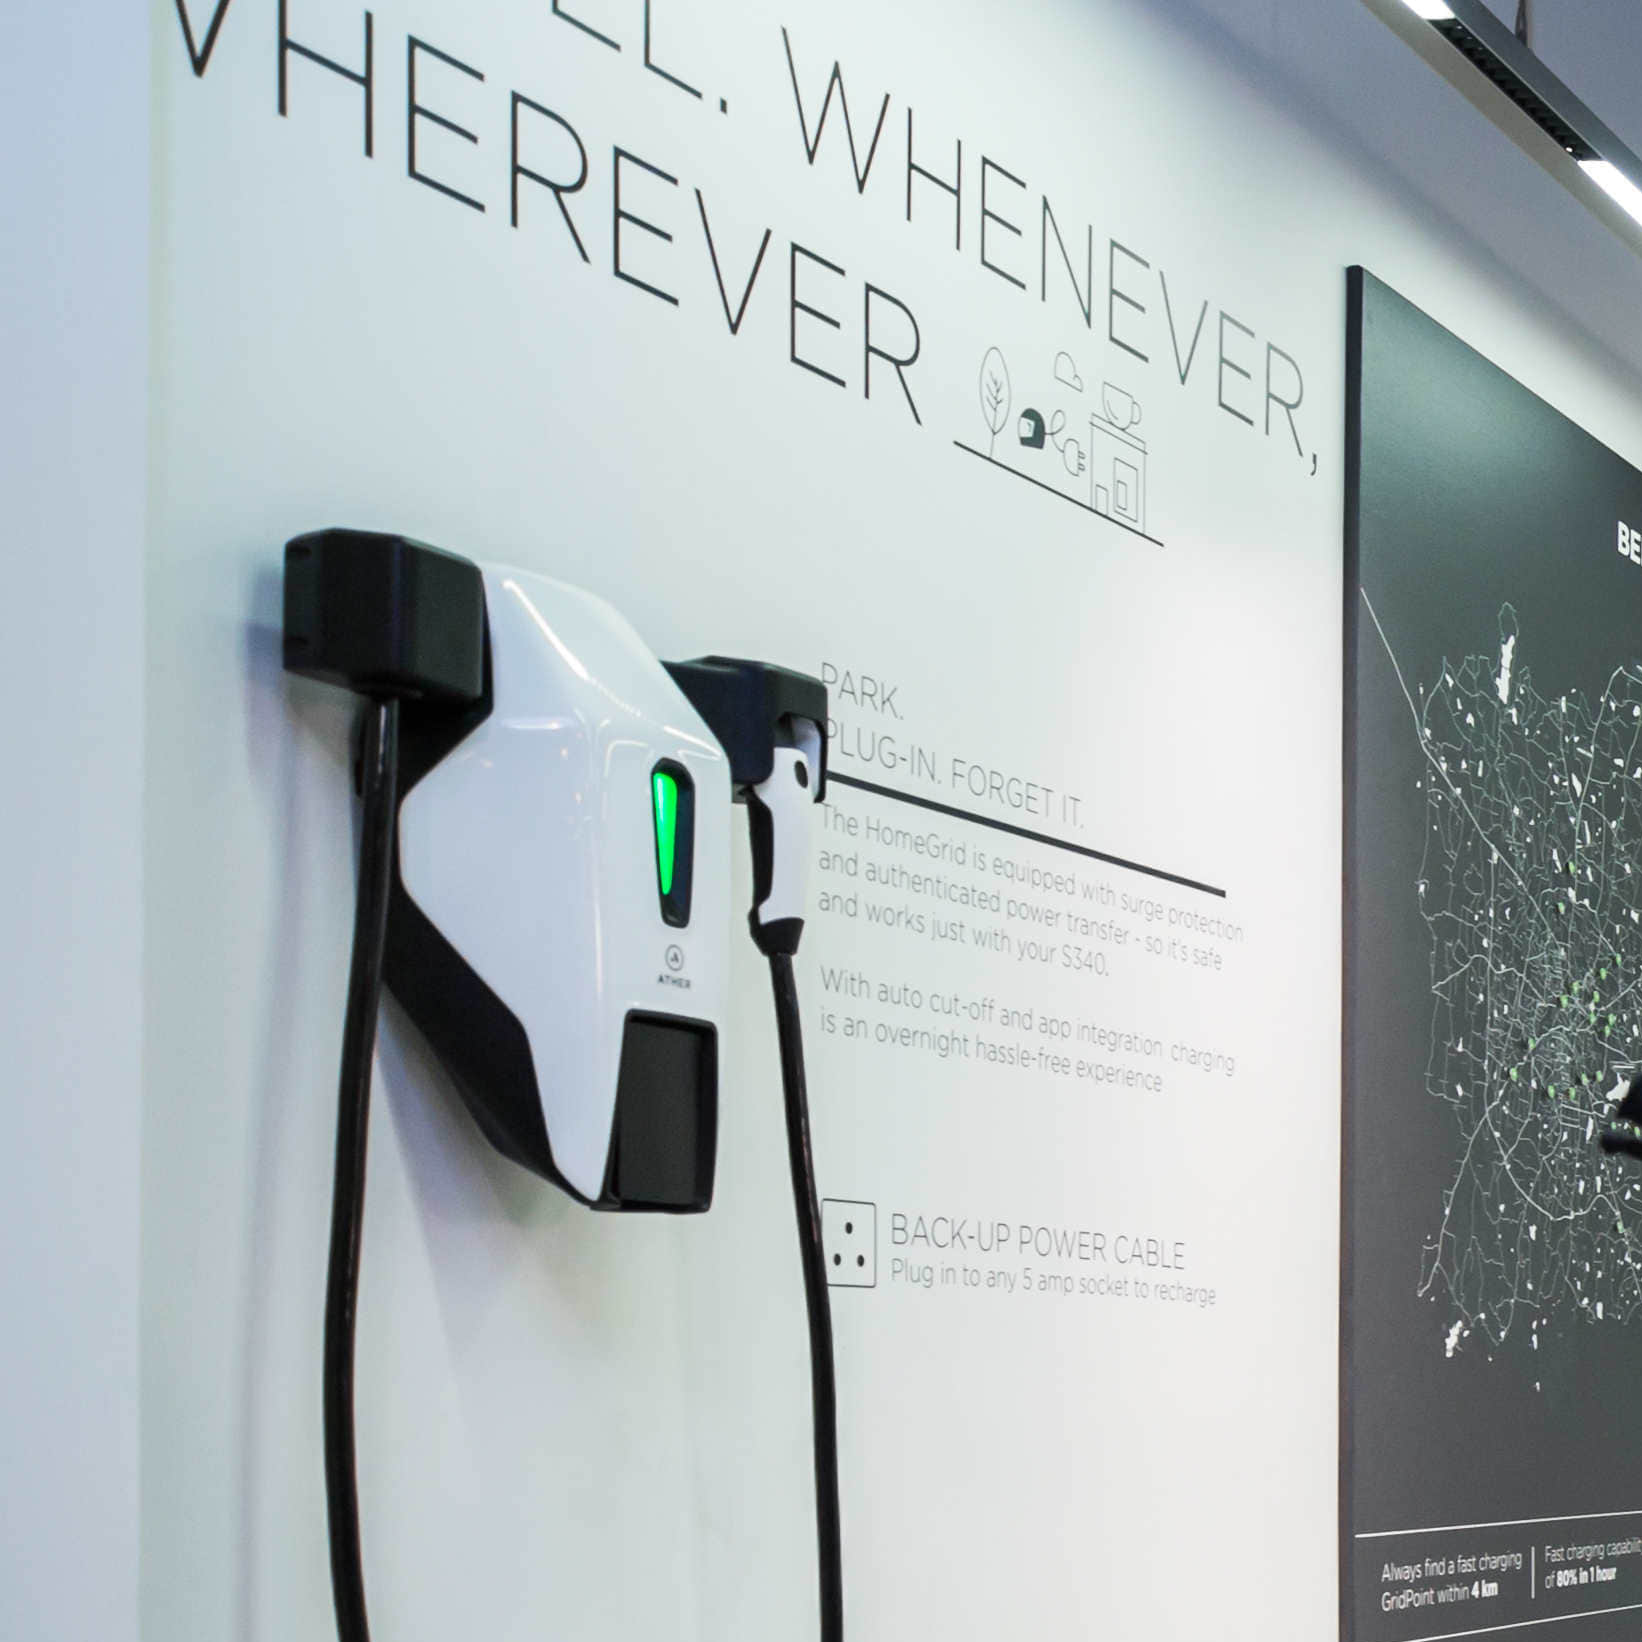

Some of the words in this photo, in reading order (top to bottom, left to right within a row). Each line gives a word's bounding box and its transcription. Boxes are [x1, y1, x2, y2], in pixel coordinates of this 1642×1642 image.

[781, 25, 1318, 475] WHENEVER,
[821, 661, 904, 720] PARK.
[952, 758, 1054, 818] FORGET
[1062, 795, 1084, 828] IT.
[821, 802, 858, 836] The
[866, 816, 966, 865] HomeGrid
[973, 842, 985, 871] is
[993, 856, 1075, 895] equipped
[1082, 880, 1115, 906] with
[1121, 893, 1164, 922] surge
[1169, 907, 1244, 942] protection
[818, 891, 858, 917] and
[865, 903, 925, 934] works
[931, 912, 965, 943] just
[972, 926, 1011, 953] with
[1016, 938, 1055, 963] your
[1062, 944, 1109, 976] S340.
[819, 850, 858, 876] and
[865, 862, 1000, 912] authenticated
[1007, 899, 1061, 927] power
[1067, 913, 1129, 945] transfer
[1145, 935, 1162, 955] so
[1168, 938, 1187, 962] it's
[1193, 947, 1222, 970] safe
[657, 974, 691, 989] ATHER
[820, 964, 870, 998] With
[878, 982, 922, 1008] auto
[929, 992, 994, 1023] cut-off
[1000, 1007, 1033, 1030] and
[1039, 1016, 1072, 1041] app
[1077, 1017, 1162, 1056] integration
[1171, 1040, 1235, 1077] charging
[820, 1006, 836, 1034] is
[843, 1016, 868, 1038] an
[875, 1023, 968, 1058] overnight
[976, 1034, 1071, 1075] hassle-free
[1077, 1059, 1162, 1093] experience
[891, 1213, 1010, 1252] BACK-UP
[1019, 1225, 1106, 1262] POWER
[1114, 1235, 1184, 1270] CABLE
[892, 1258, 933, 1288] Plug
[941, 1261, 956, 1284] in
[963, 1265, 980, 1287] to
[986, 1270, 1016, 1293] any
[1023, 1268, 1033, 1290] 5
[1038, 1274, 1073, 1296] amp
[1080, 1275, 1128, 1297] socket
[1135, 1280, 1149, 1298] to
[1154, 1281, 1216, 1308] recharge
[1381, 1562, 1422, 1582] Always
[1425, 1557, 1446, 1577] find
[1447, 1560, 1455, 1574] a
[1457, 1555, 1476, 1573] fast
[1479, 1550, 1522, 1571] charging
[1381, 1587, 1435, 1611] GridPoint
[1437, 1583, 1470, 1603] within
[1471, 1581, 1480, 1598] 4
[1481, 1579, 1498, 1598] km
[1545, 1570, 1555, 1588] of
[1556, 1568, 1577, 1587] 80%
[1579, 1566, 1589, 1584] in
[1590, 1565, 1595, 1583] 1
[1596, 1565, 1617, 1581] hour
